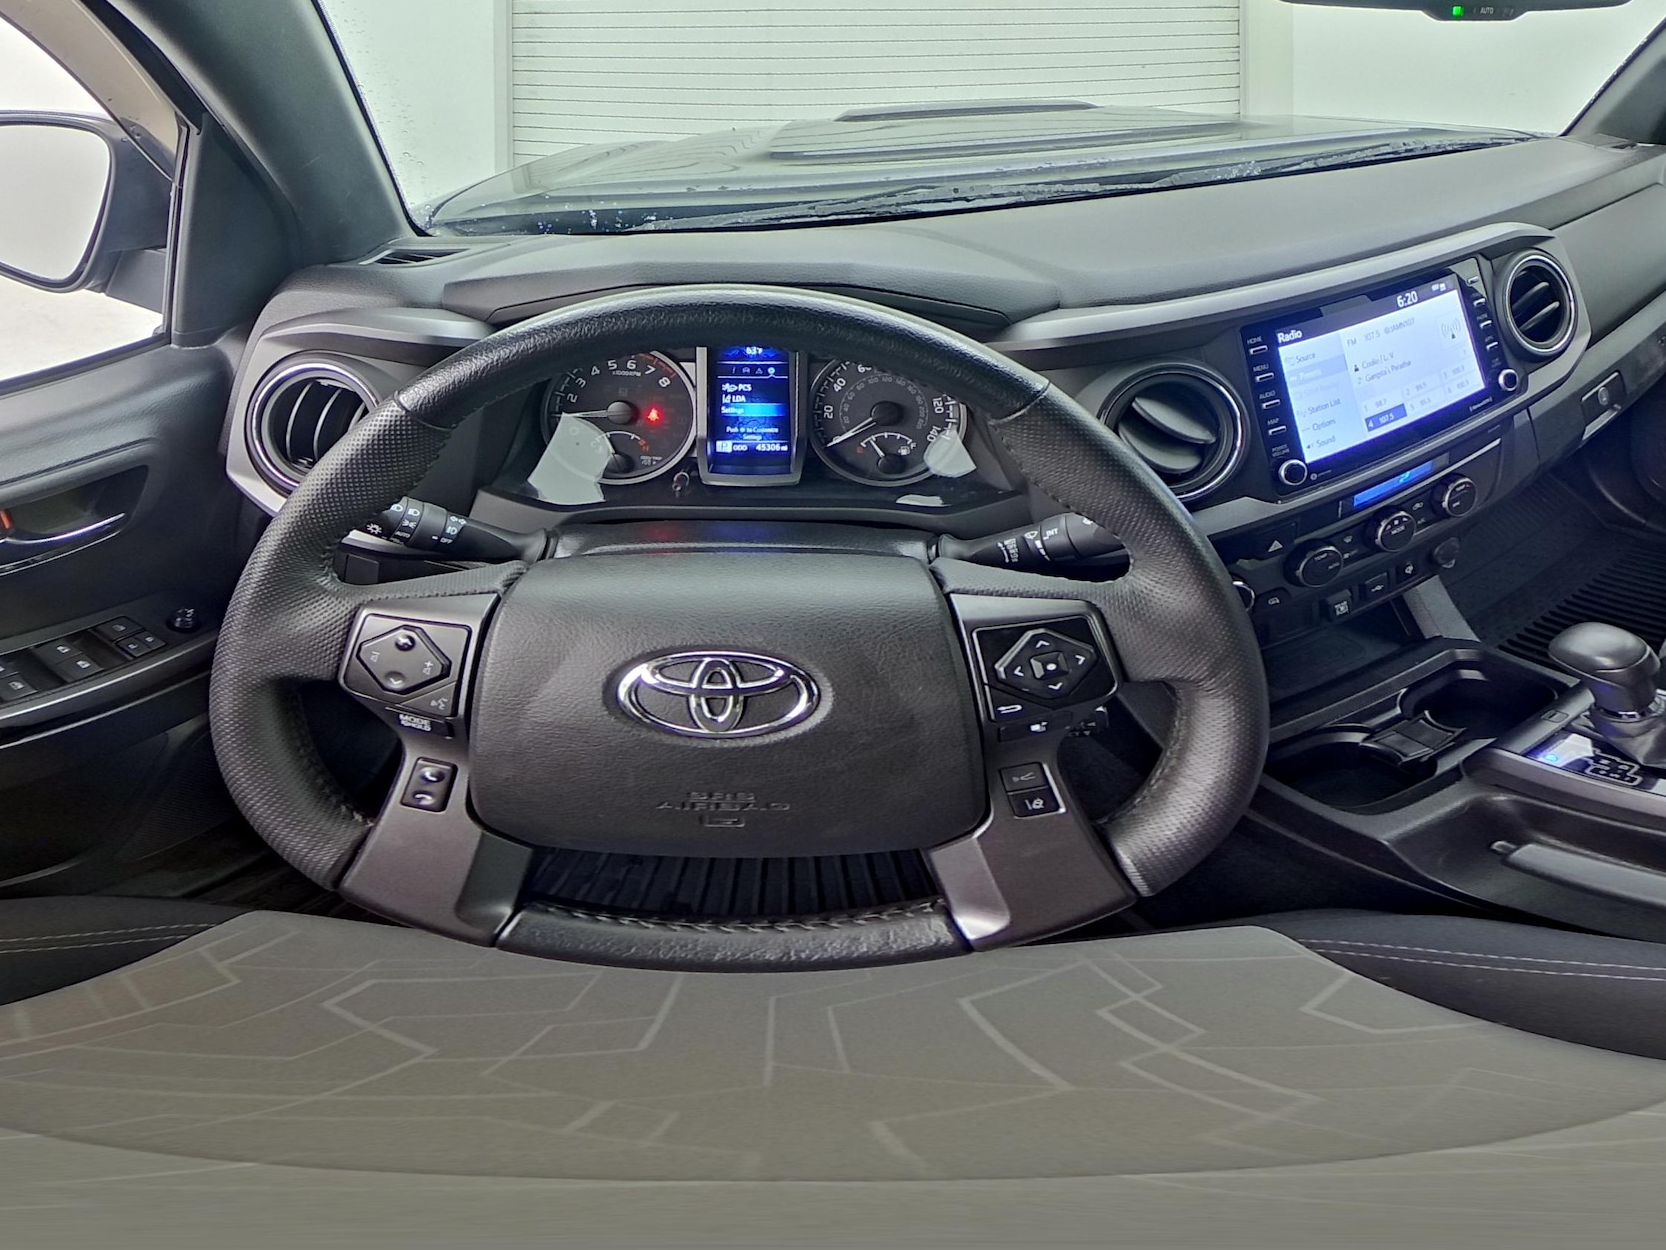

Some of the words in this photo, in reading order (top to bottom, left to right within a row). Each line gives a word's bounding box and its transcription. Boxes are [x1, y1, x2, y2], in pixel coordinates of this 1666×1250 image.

[1396, 291, 1418, 308] 6:20
[1278, 329, 1303, 343] Radio
[607, 359, 618, 370] 5
[1296, 353, 1316, 364] Source
[591, 366, 600, 376] 4
[626, 360, 637, 370] 6
[644, 365, 656, 376] 7
[576, 377, 587, 388] 3
[658, 376, 671, 388] 8
[833, 377, 846, 392] 40
[567, 393, 578, 403] 2
[1259, 390, 1276, 400] AUDIO
[932, 397, 944, 414] 120
[1307, 403, 1329, 415] Station
[1330, 398, 1341, 409] List
[823, 405, 834, 419] 20
[1312, 419, 1336, 432] Options
[1316, 436, 1336, 448] Sound
[399, 713, 431, 726] MODE
